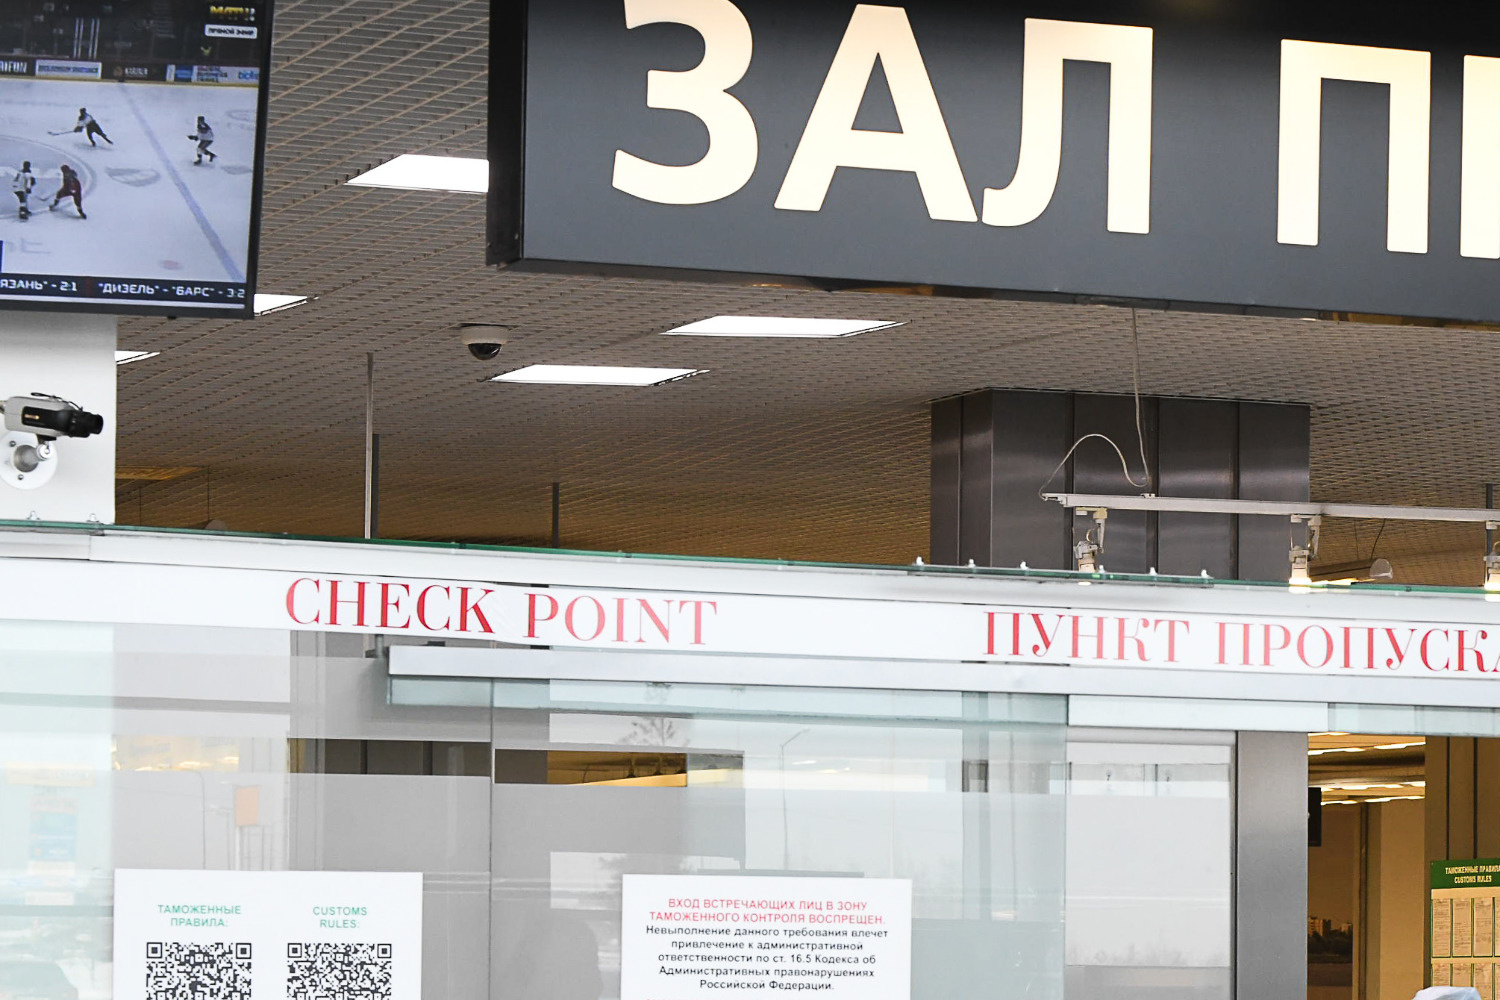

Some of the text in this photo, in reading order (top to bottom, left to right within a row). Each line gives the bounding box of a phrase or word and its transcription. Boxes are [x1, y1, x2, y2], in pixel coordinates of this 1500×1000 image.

[612, 0, 1153, 234] ЗАЛ
[285, 577, 718, 646] CHECK POINT
[983, 611, 1190, 662] ПУНКТ
[1477, 875, 1492, 883] RULES
[157, 904, 241, 915] ТАМОЖЕННЫЕ
[312, 906, 368, 916] CUSTOMS
[668, 899, 867, 911] ВХОД ВСТРЕЧАЮЩИХ ЛИЦ В ЗОНУ
[170, 917, 229, 928] ПРАВИЛА:
[319, 919, 360, 929] RULES:
[649, 912, 887, 924] ТАМОЖЕННОГО КОНТРОЛЯ ВОСПРЕЩЕН.
[646, 926, 888, 938] Невыполнение данного требования влечет
[671, 941, 745, 950] привлечение
[757, 942, 863, 952] административной
[657, 954, 876, 964] ответственности по ст. 16.5 Кодекса об
[659, 966, 874, 978] Административных правонарушениях
[699, 979, 835, 992] Российской Федерации.
